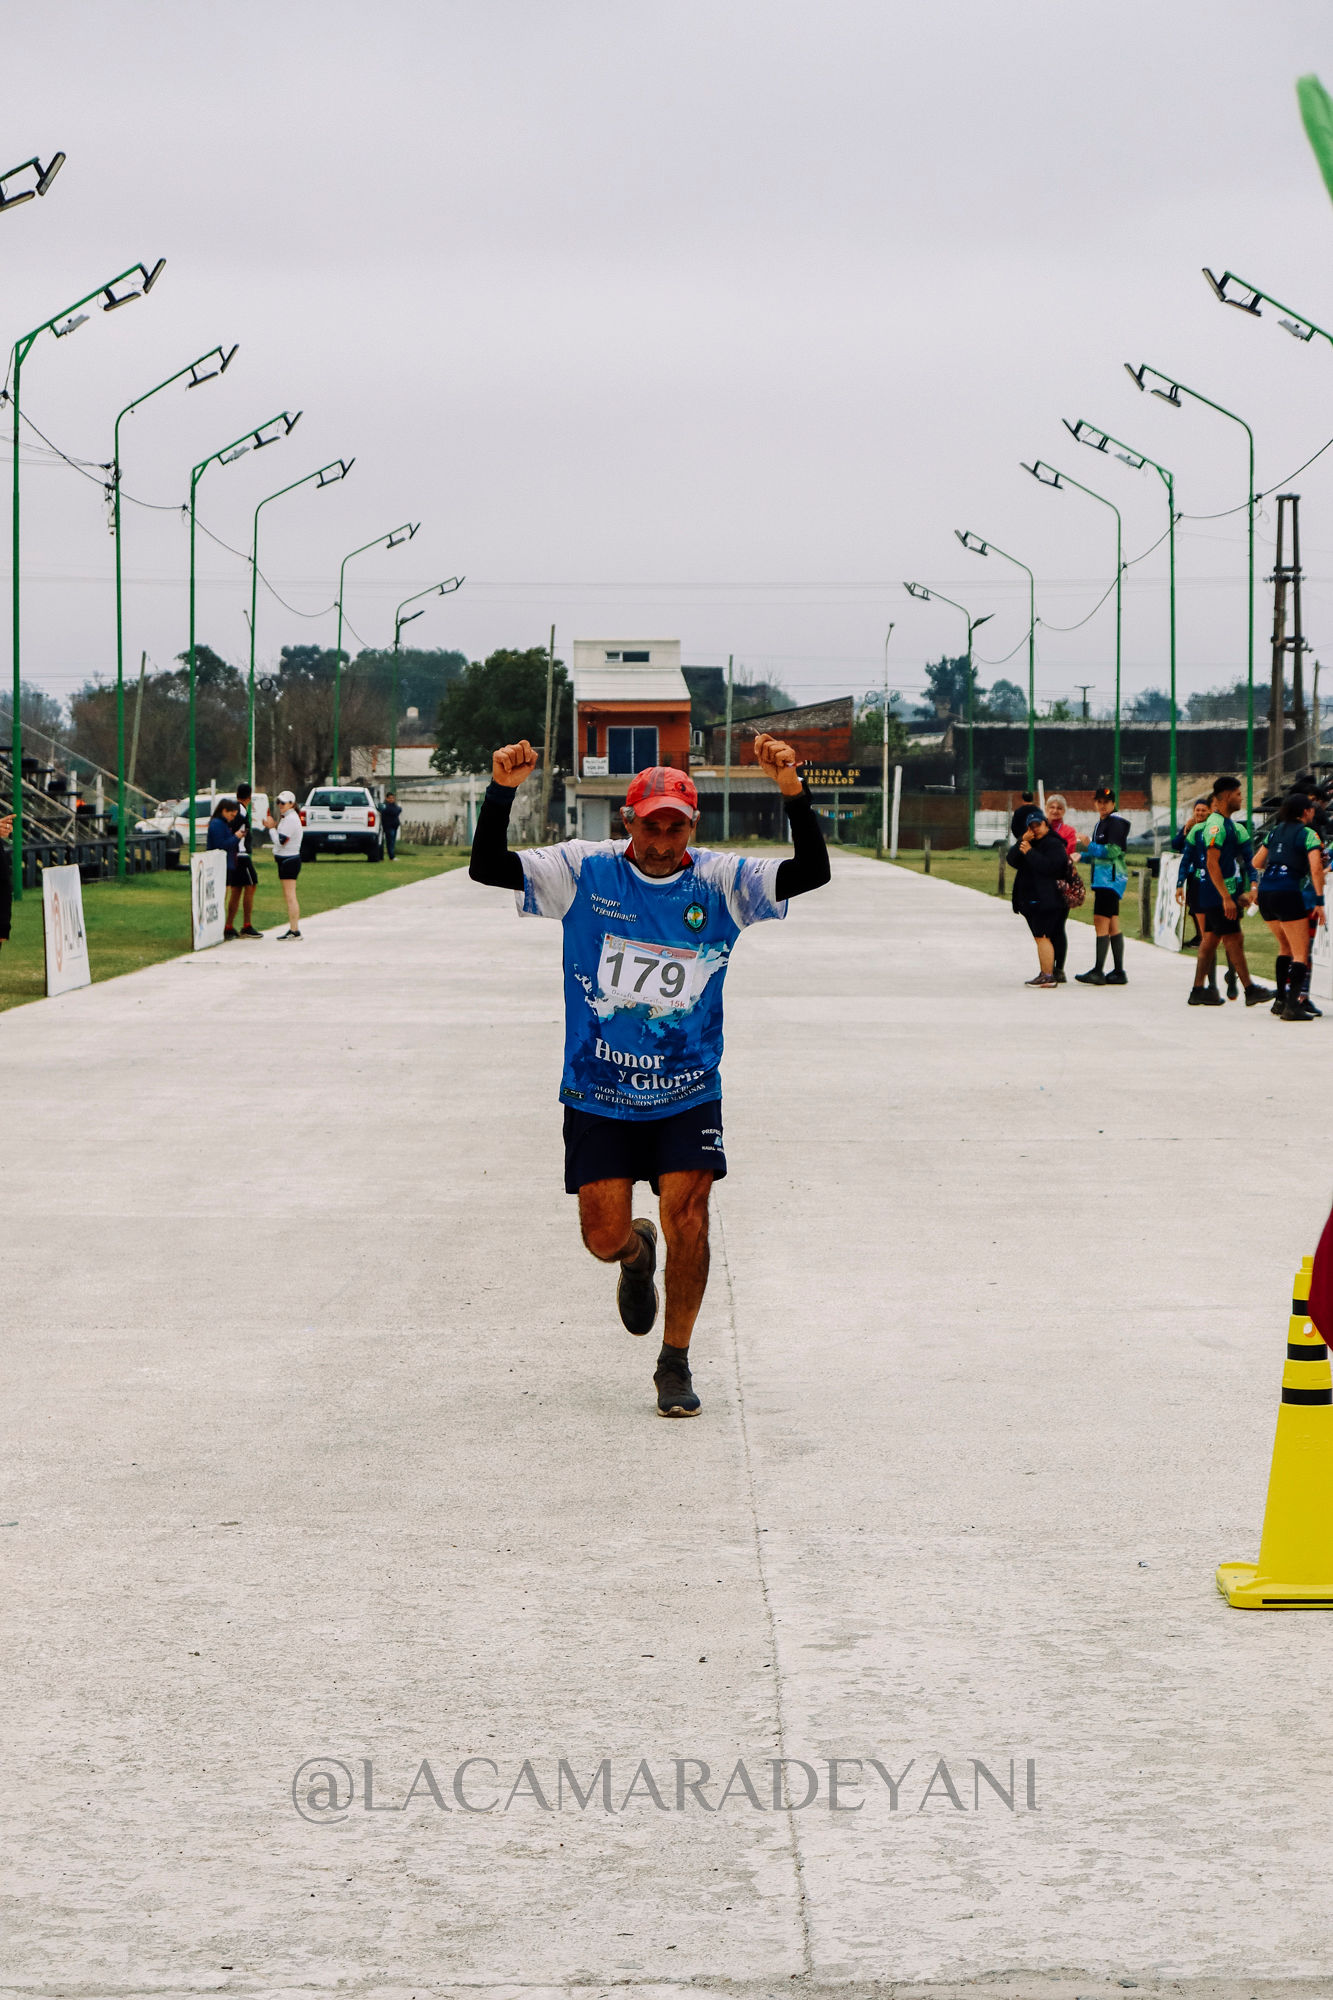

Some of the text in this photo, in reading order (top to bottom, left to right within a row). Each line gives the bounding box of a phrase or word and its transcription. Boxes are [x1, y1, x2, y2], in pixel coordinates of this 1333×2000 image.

[606, 951, 686, 998] 179
[669, 1000, 686, 1009] 15k
[595, 1038, 665, 1070] Honor
[618, 1069, 705, 1091] y Gloria
[594, 1092, 610, 1102] QUE
[611, 1096, 652, 1107] LUCHARON
[653, 1097, 670, 1106] POR
